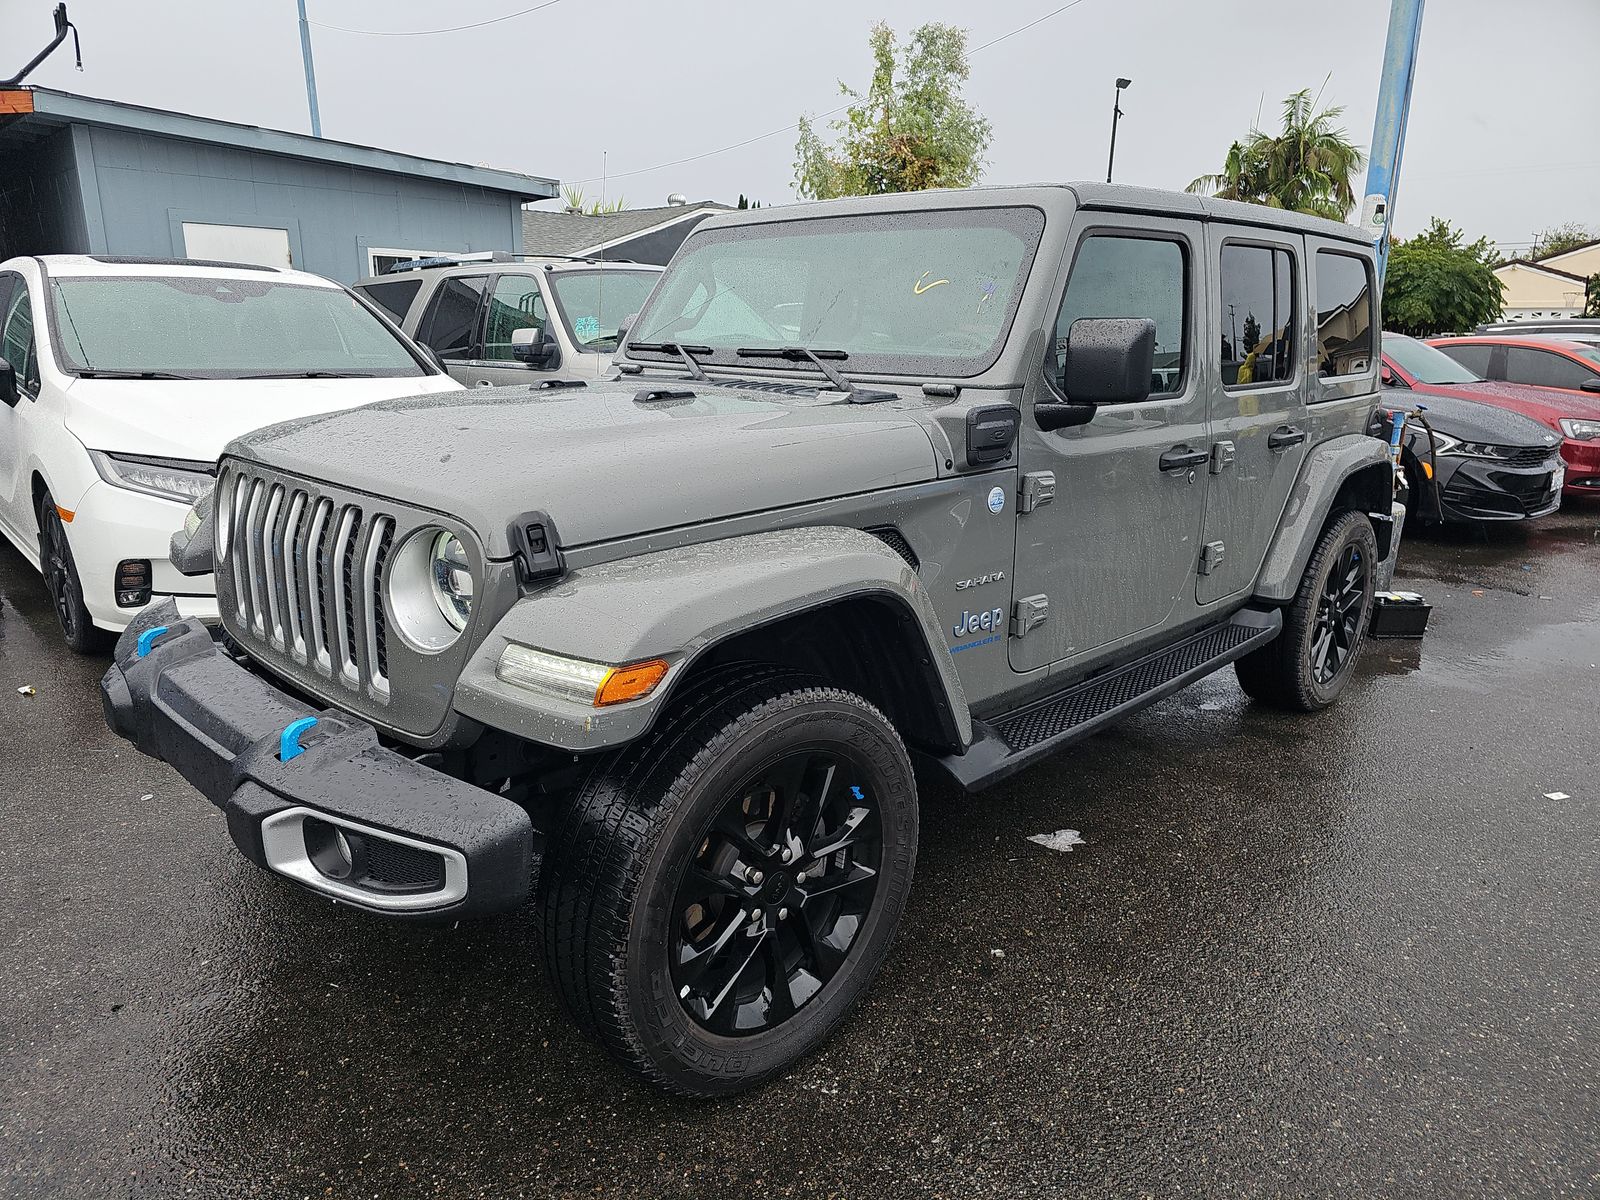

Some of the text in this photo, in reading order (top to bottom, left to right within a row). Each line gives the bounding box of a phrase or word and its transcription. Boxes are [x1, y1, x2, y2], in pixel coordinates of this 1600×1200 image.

[955, 571, 1005, 591] SAHARA
[953, 607, 1003, 638] Jeep
[846, 726, 912, 916] BRIDGESTONE
